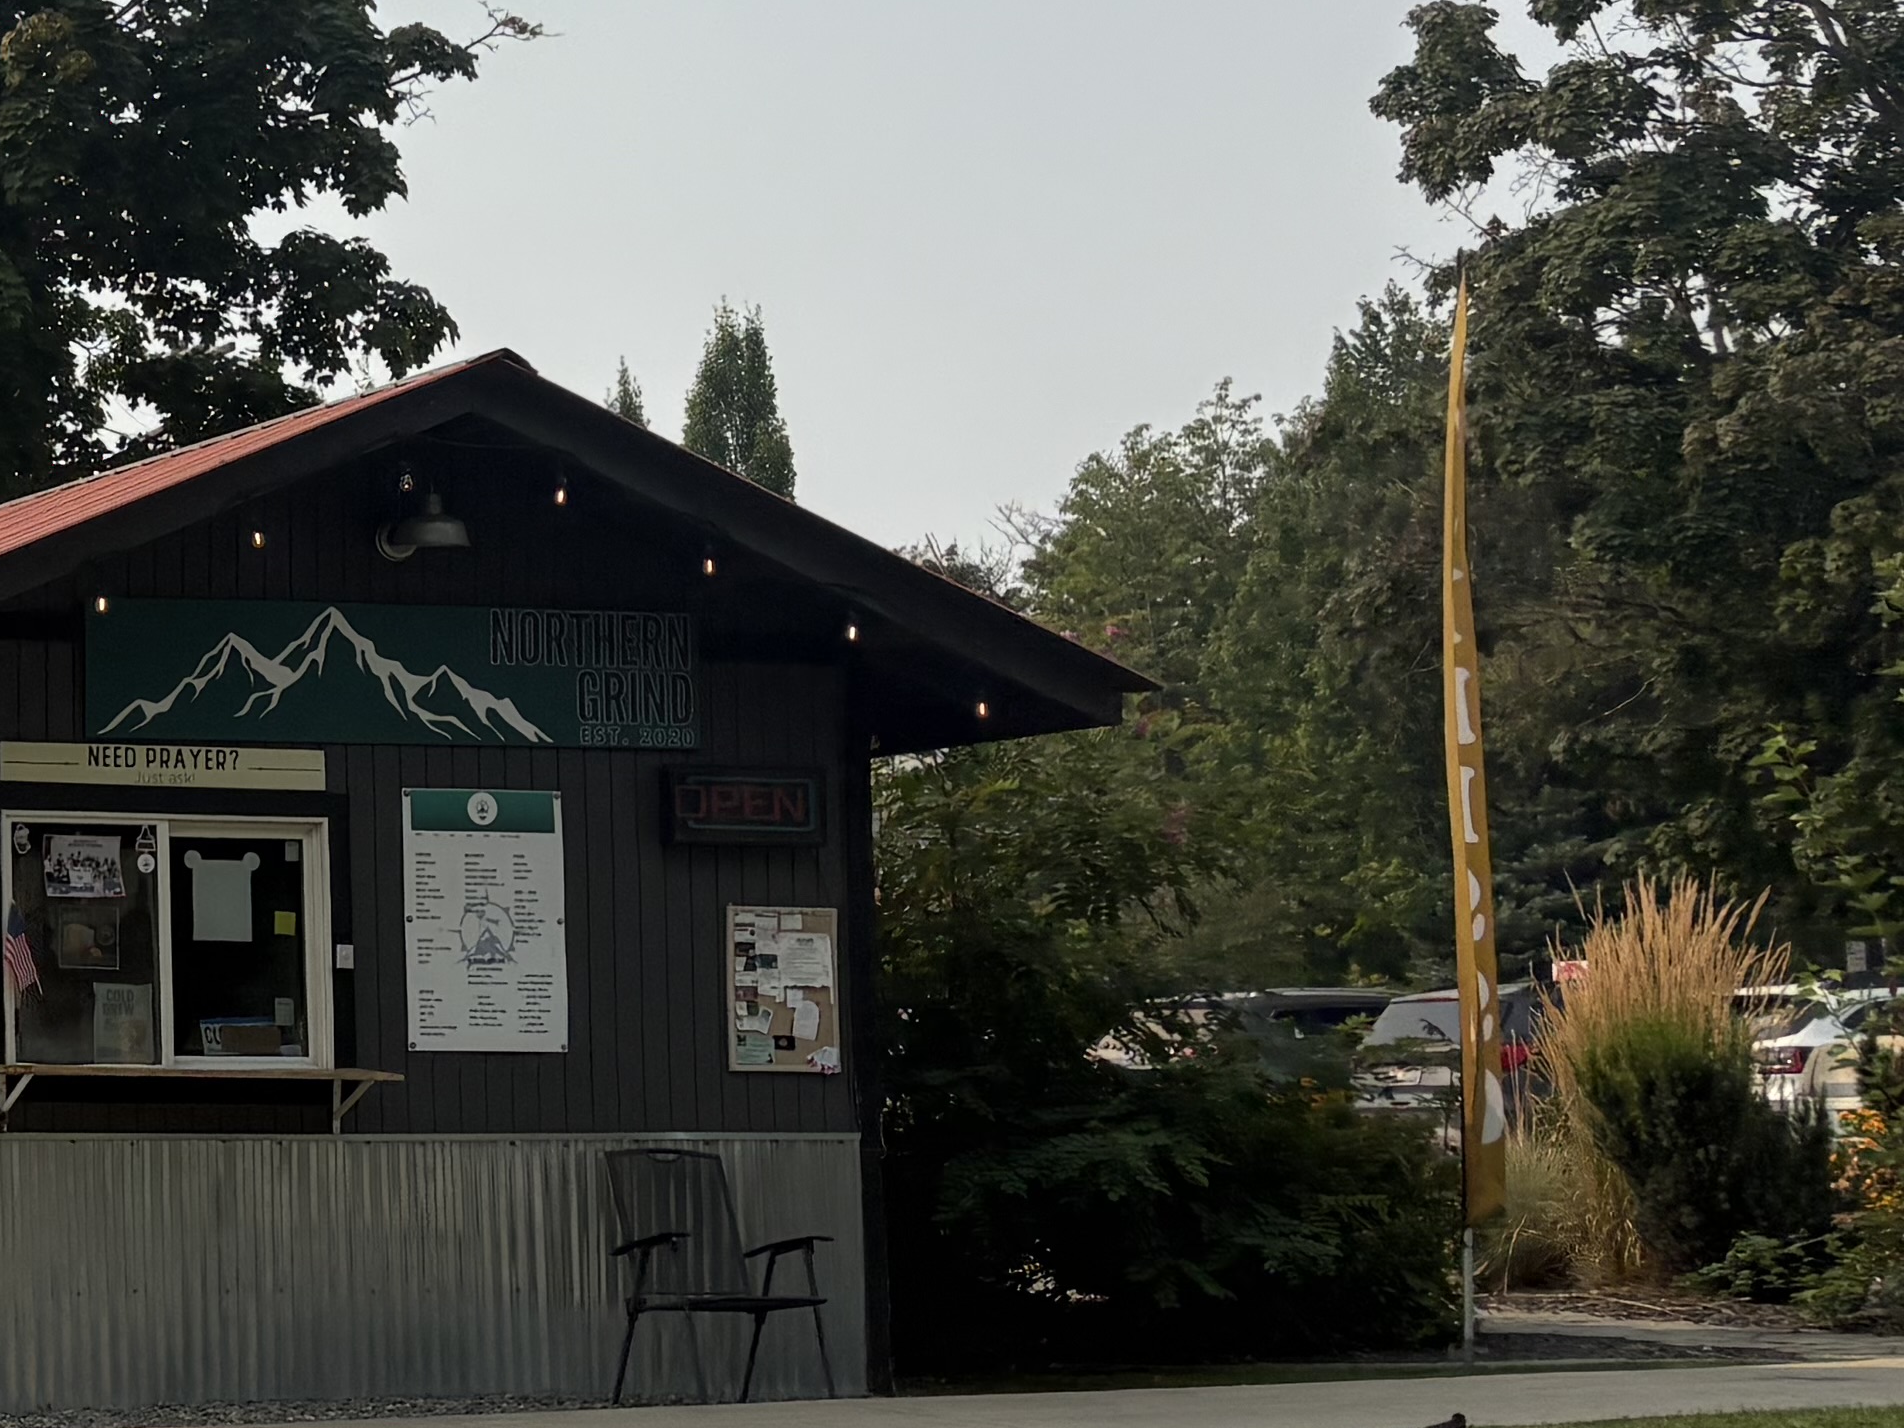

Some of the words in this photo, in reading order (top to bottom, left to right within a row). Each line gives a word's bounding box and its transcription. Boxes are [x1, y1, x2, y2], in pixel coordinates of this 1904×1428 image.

[490, 608, 691, 671] NORTHERN
[577, 669, 694, 726] GRIND
[580, 725, 629, 746] EST.
[640, 728, 694, 747] 2020
[88, 745, 136, 768] NEED
[145, 747, 240, 771] PRAYER?
[675, 784, 806, 823] OPEN
